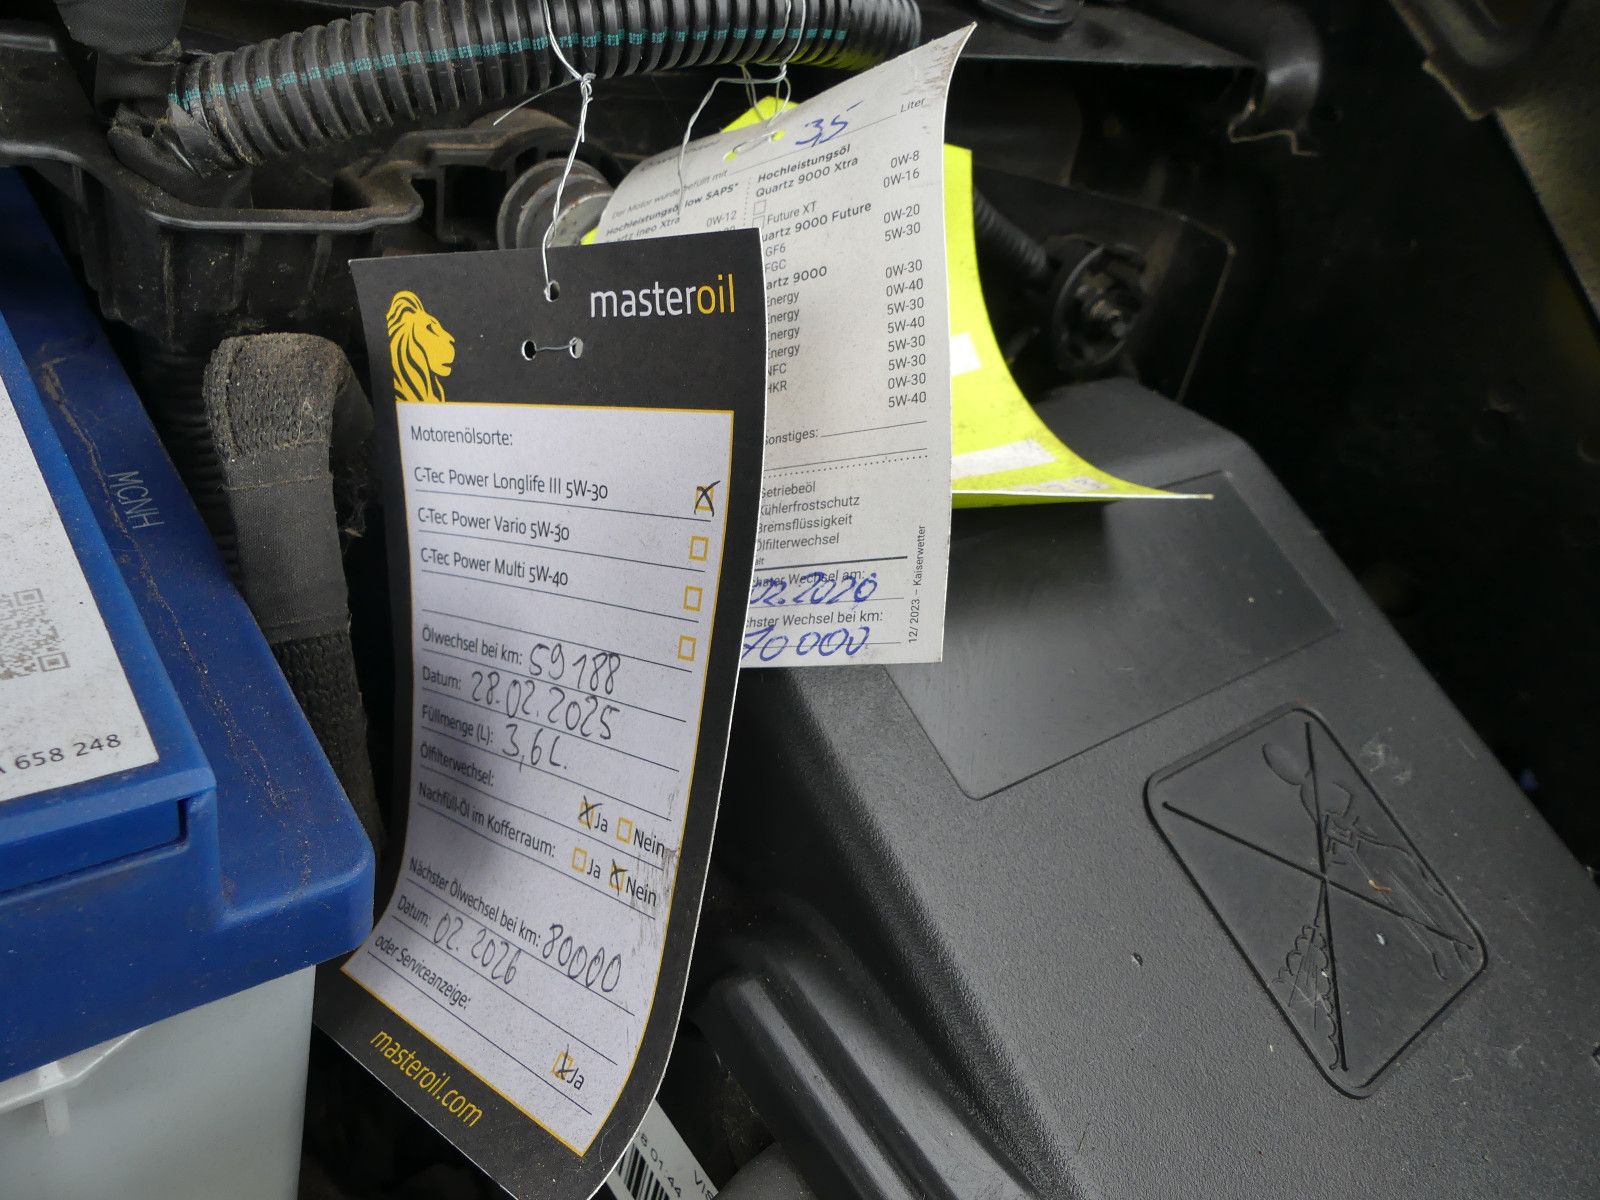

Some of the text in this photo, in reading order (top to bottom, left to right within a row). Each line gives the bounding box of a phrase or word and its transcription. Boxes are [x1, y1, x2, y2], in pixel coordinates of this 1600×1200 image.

[900, 97, 925, 112] Liter
[757, 143, 851, 183] Hochleistungsöl
[889, 150, 920, 169] 0W-8
[756, 157, 858, 198] Quartz 9000 Xtra
[684, 194, 703, 208] low
[766, 168, 920, 225] Future XT 0W-16
[762, 202, 872, 242] uartz 9000 Future
[883, 203, 920, 224] 0W-20
[884, 221, 921, 242] 5W-30
[766, 265, 828, 291] artz 9000
[885, 258, 923, 279] 0W-30
[590, 273, 736, 318] masteroil
[885, 277, 924, 297] 0W-40
[887, 296, 925, 316] 5W-30
[887, 315, 926, 334] 5W-40
[888, 334, 926, 353] 5W-30
[888, 353, 926, 372] 5W-30
[887, 372, 927, 390] 0W-30
[888, 391, 927, 409] 5W-40
[411, 425, 513, 446] Motorenölsorte:
[414, 466, 608, 501] C-Tec Power Longlife III 5W-30
[417, 506, 570, 542] C-Tec Power Vario 5W-30
[420, 547, 568, 587] C-Tec Power Multi 5W-40
[913, 525, 926, 586] Kaiserwetter
[782, 611, 834, 627] Wechsel
[837, 610, 857, 624] bei
[859, 609, 884, 622] km:
[422, 624, 523, 665] Ölwechsel bei km:
[422, 665, 462, 691] Datum:
[422, 704, 474, 737] Füllmenge
[14, 734, 122, 770] 658 248
[420, 742, 494, 787] Ölfilterwechsel:
[418, 782, 657, 907] Nachfüll-Öl im Kofferraum: Ja Nein
[593, 812, 665, 859] Ja Nein
[397, 894, 432, 928] Datum:
[408, 856, 542, 948] Nächster Ölwechsel bei km:
[375, 933, 472, 1010] oder Serviceanzeige:
[370, 1030, 483, 1127] masteroil.com
[566, 1067, 585, 1091] Ja
